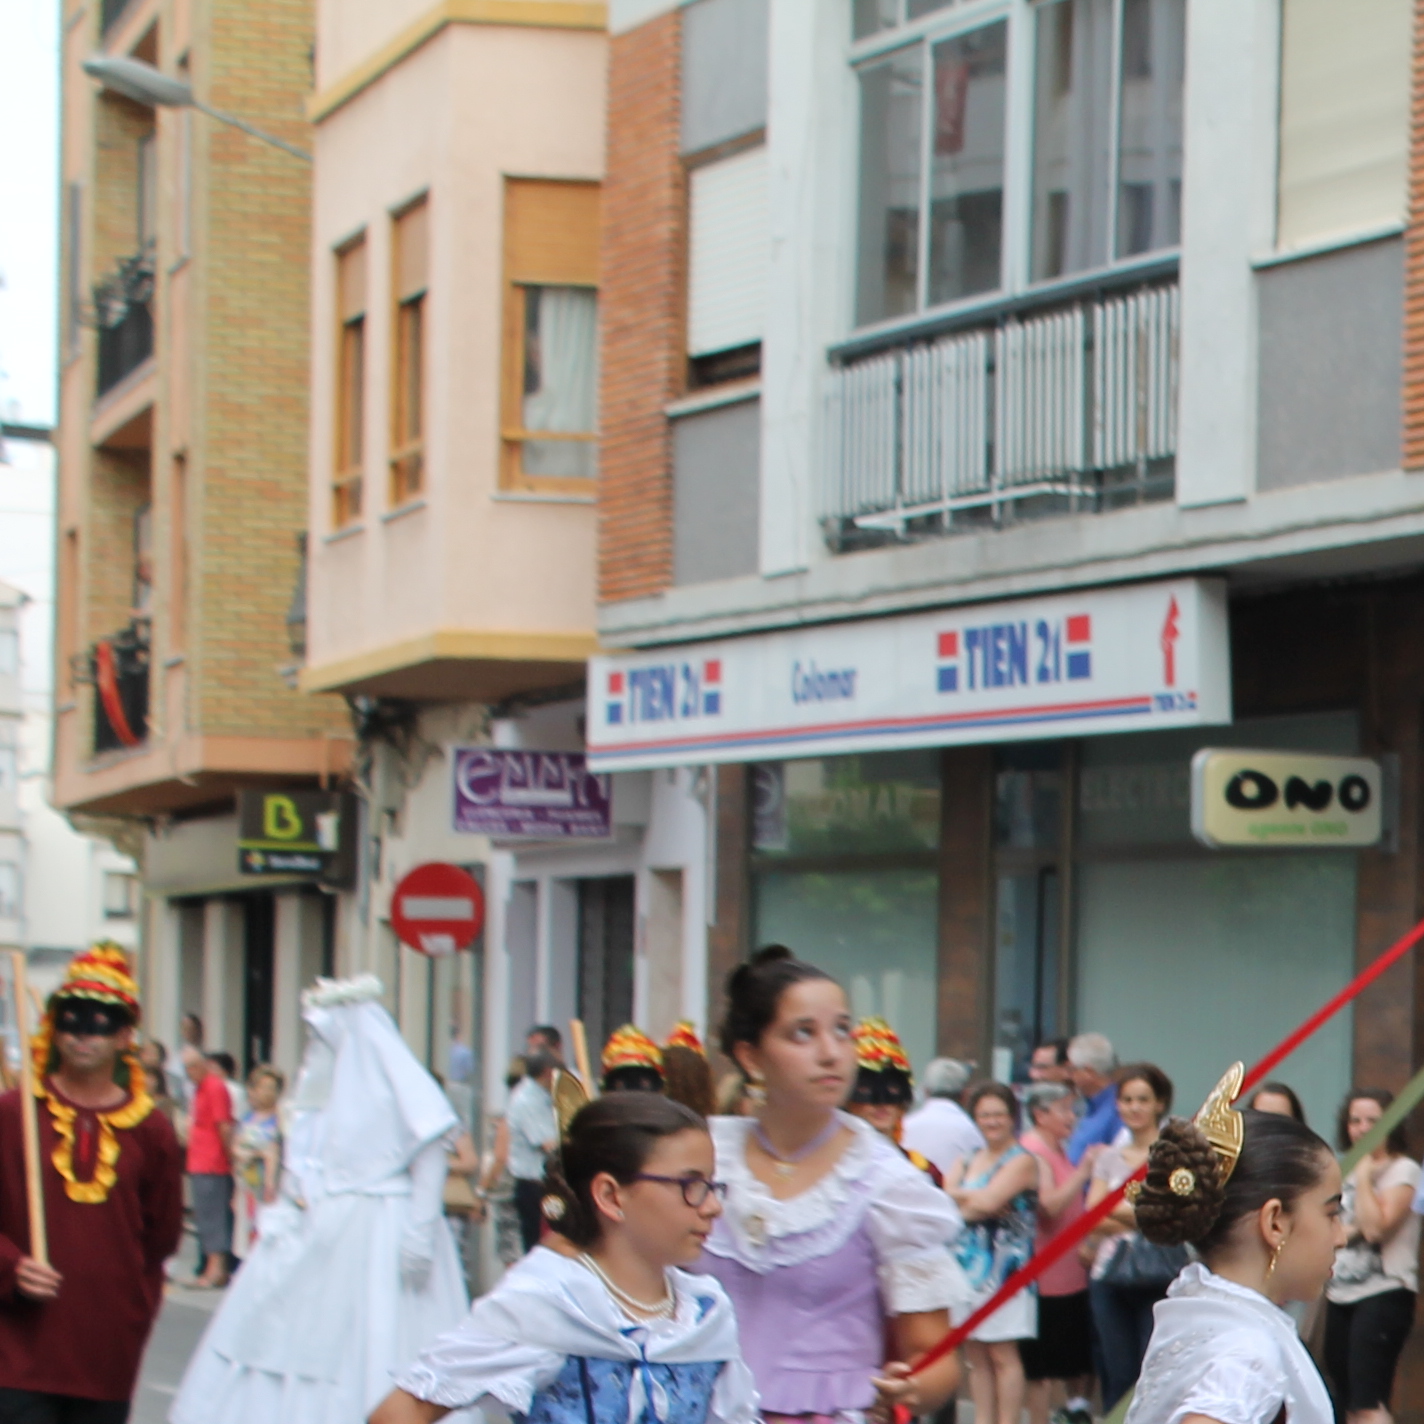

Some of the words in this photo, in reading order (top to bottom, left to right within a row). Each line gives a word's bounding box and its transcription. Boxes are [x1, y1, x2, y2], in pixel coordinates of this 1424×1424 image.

[964, 620, 1028, 690] TIEN
[1036, 618, 1061, 684] 21
[628, 665, 676, 722] TIEN
[681, 661, 699, 718] 21
[263, 794, 302, 840] B
[1224, 768, 1372, 814] ONO
